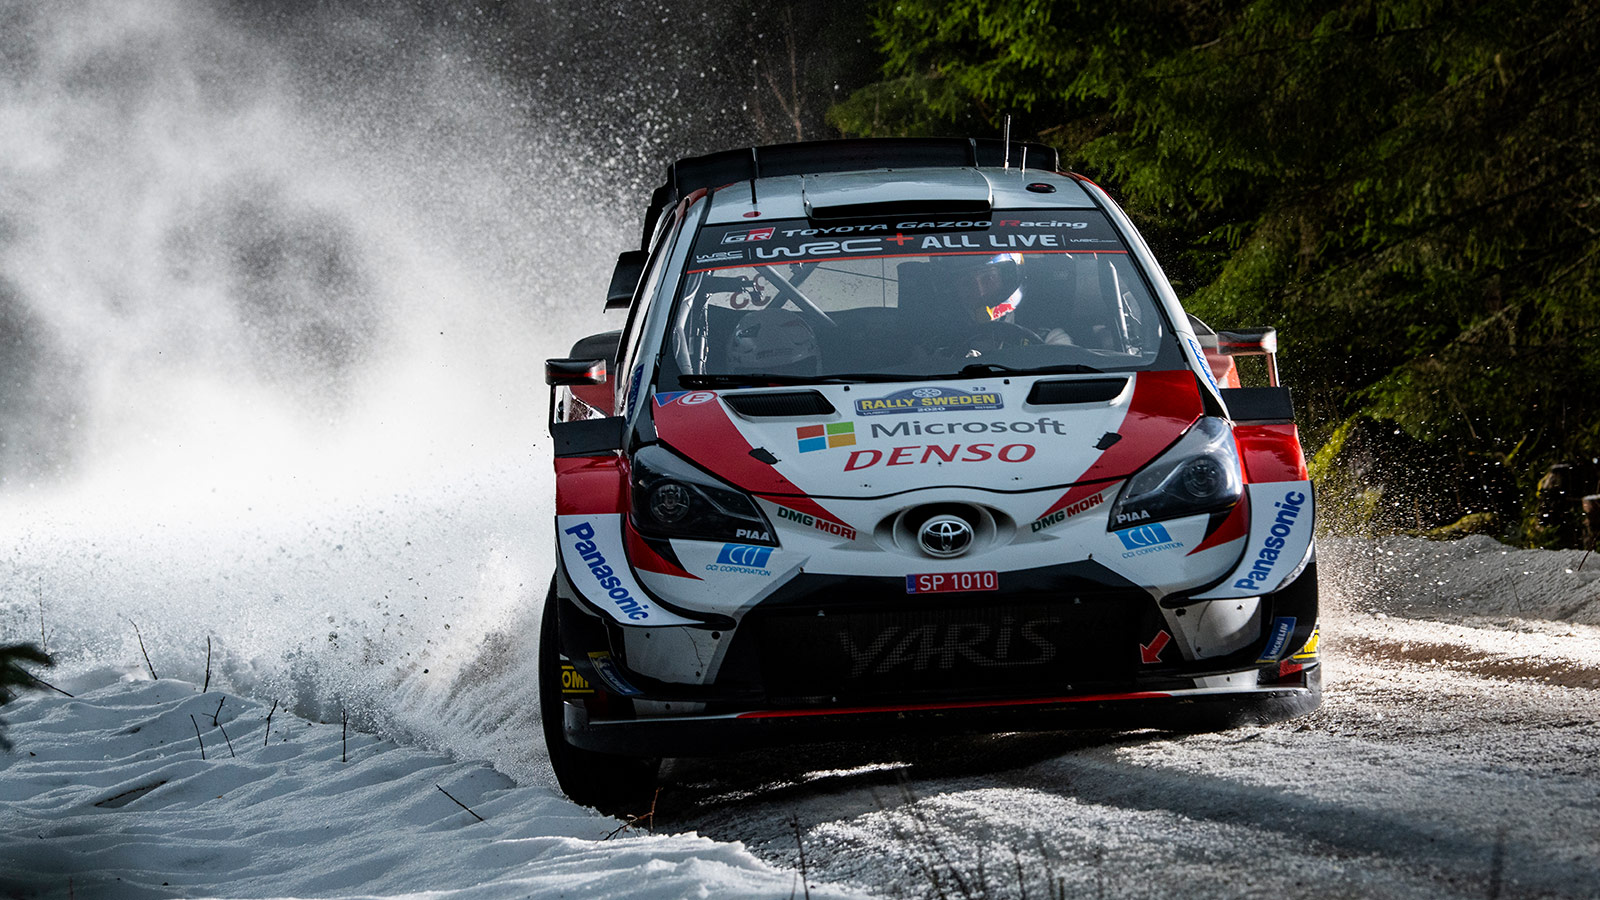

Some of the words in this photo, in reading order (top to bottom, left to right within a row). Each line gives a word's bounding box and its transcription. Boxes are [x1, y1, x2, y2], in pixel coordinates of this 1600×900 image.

[782, 224, 888, 237] TOYOTA
[896, 220, 993, 229] GAZOO
[1000, 219, 1088, 230] Racing
[724, 231, 770, 243] GR
[921, 235, 981, 249] ALL
[989, 234, 1059, 247] LIVE
[688, 393, 708, 403] E
[861, 398, 915, 410] RALLY
[921, 394, 996, 406] SWEDEN
[870, 417, 1067, 438] Microsoft
[843, 443, 1036, 472] DENSO
[1031, 511, 1066, 533] DMG
[1066, 493, 1104, 518] MORI
[1116, 509, 1151, 524] PIAA
[777, 506, 814, 527] DMG
[815, 518, 857, 541] MORI
[735, 528, 770, 541] PIAA
[1234, 491, 1305, 591] Panasonic
[1136, 541, 1184, 556] CORPORATION
[565, 521, 649, 621] Panasonic
[720, 565, 771, 576] CORPORATION
[920, 575, 945, 591] SP
[951, 573, 995, 589] 1010
